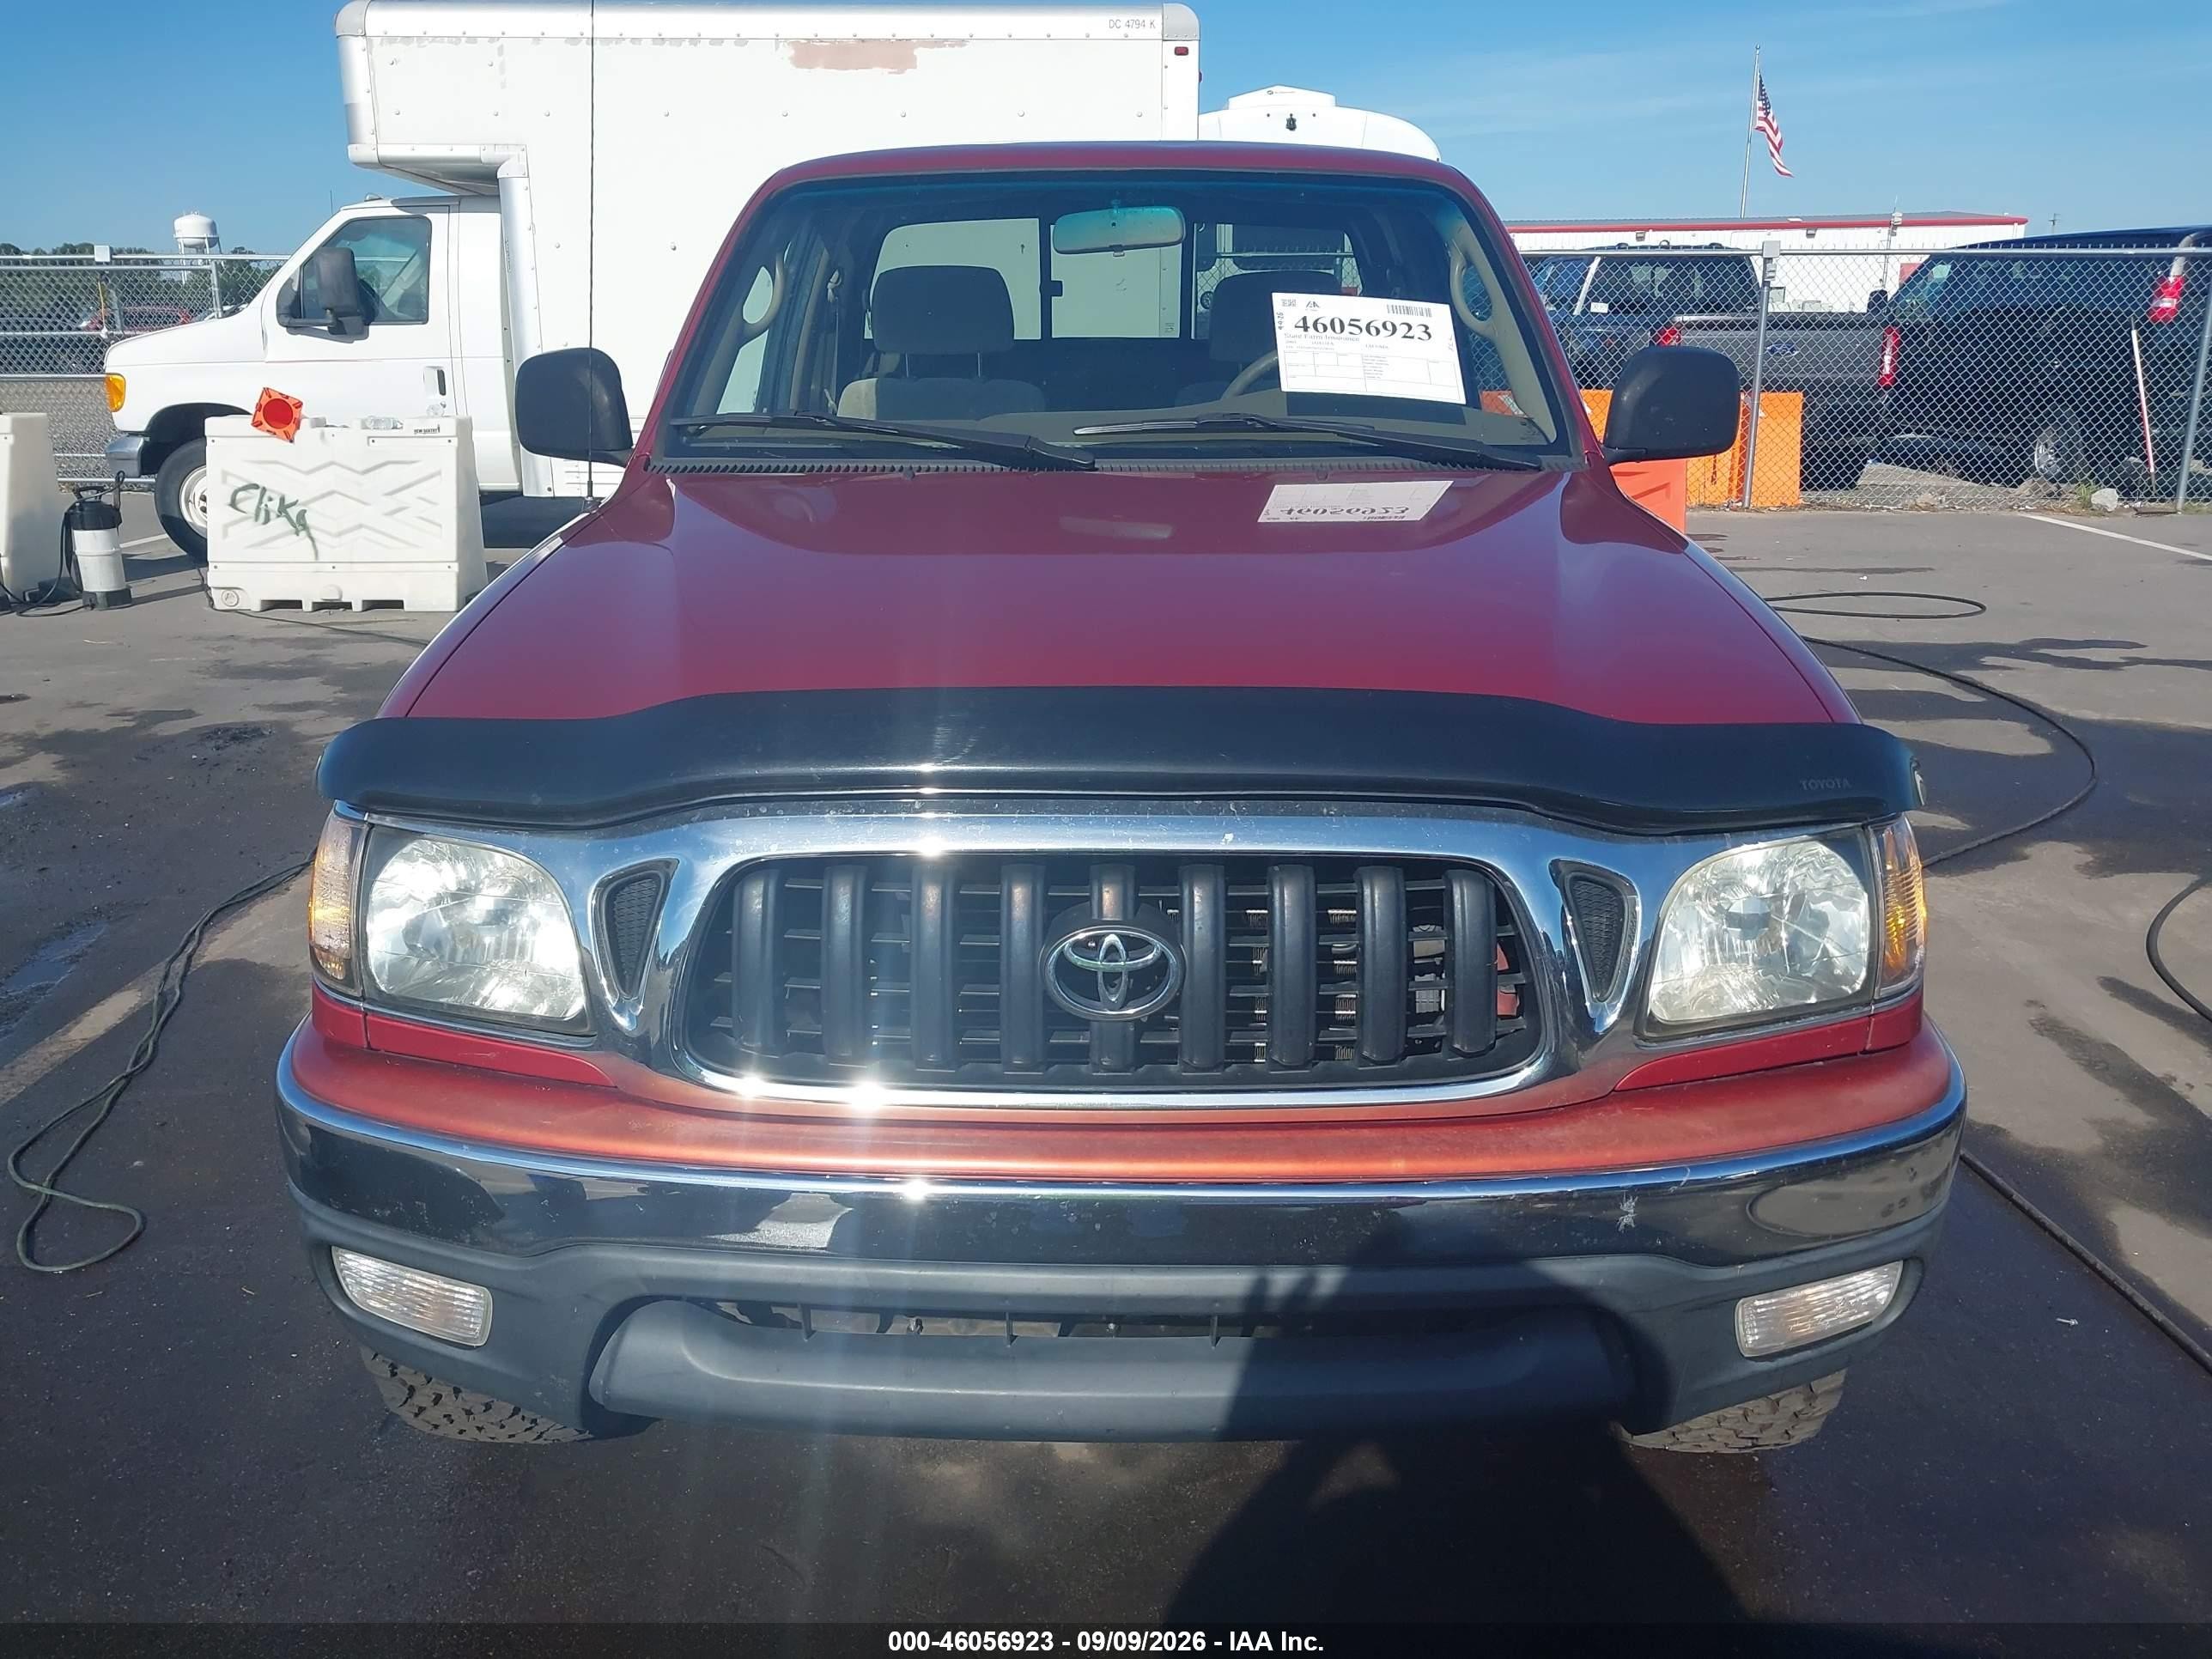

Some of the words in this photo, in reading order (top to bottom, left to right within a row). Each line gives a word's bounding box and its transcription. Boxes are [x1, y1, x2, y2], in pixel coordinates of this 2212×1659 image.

[1109, 19, 1121, 29] DC
[1125, 19, 1146, 29] 4794
[1149, 19, 1156, 29] K
[1294, 315, 1432, 341] 46056923
[1800, 778, 1853, 791] TOYOTA
